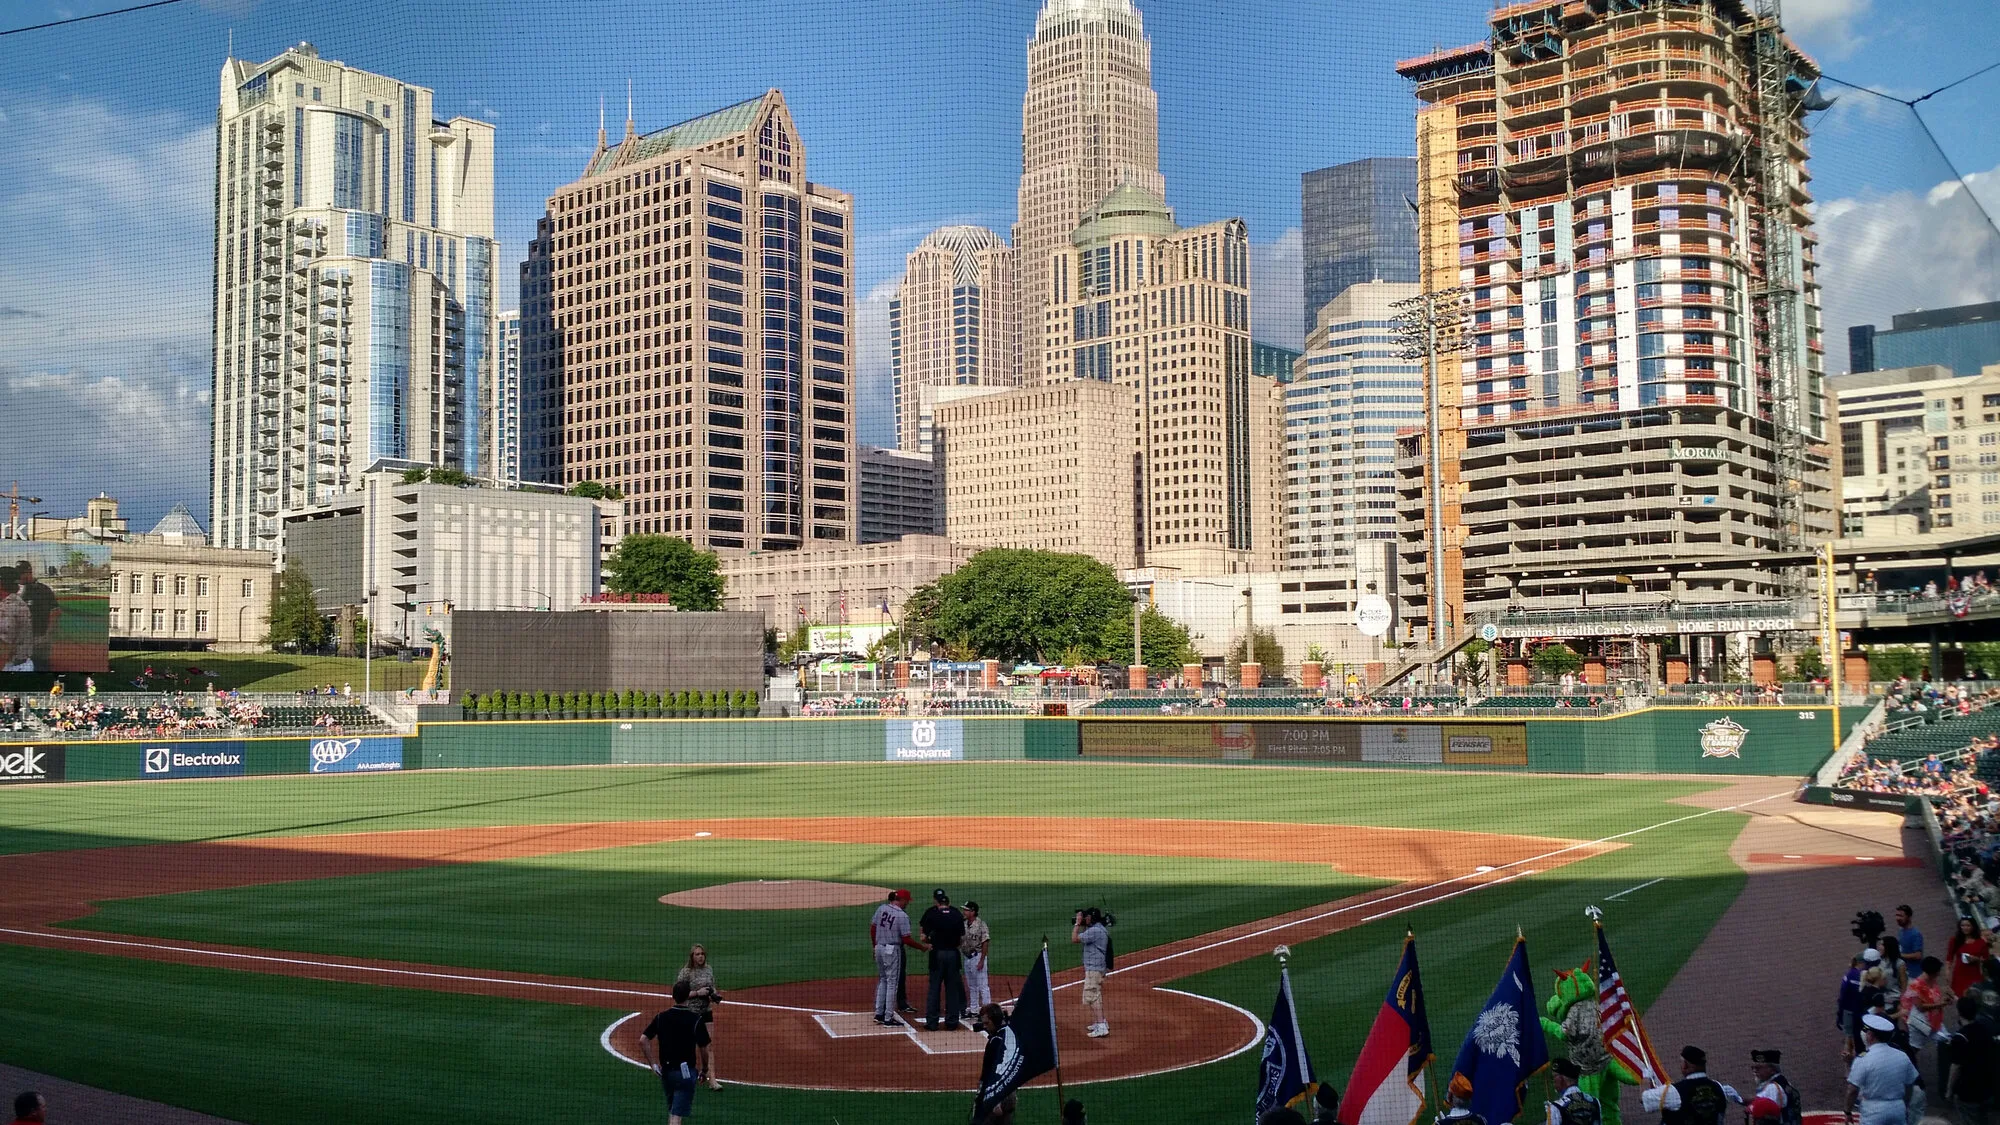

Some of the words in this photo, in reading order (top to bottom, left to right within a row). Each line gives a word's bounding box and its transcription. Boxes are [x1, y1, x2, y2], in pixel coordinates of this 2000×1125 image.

[1501, 627, 1553, 638] Carolinas
[1556, 625, 1621, 636] HealthCare
[1623, 623, 1667, 637] System
[1677, 621, 1715, 633] HOME
[1717, 620, 1744, 632] RUN
[1748, 618, 1794, 631] PORCH
[1798, 711, 1816, 720] 315
[1281, 729, 1308, 741] 7:00
[1312, 729, 1330, 741] PM
[1268, 745, 1286, 753] First
[1313, 745, 1331, 755] 7:05
[1332, 745, 1346, 755] PM
[1451, 740, 1490, 748] PENSKE
[173, 752, 241, 767] Electrolux
[317, 742, 341, 762] AAA
[896, 747, 952, 759] Husqvarna
[880, 911, 896, 930] 24
[1004, 1054, 1025, 1087] FORGOTTEN
